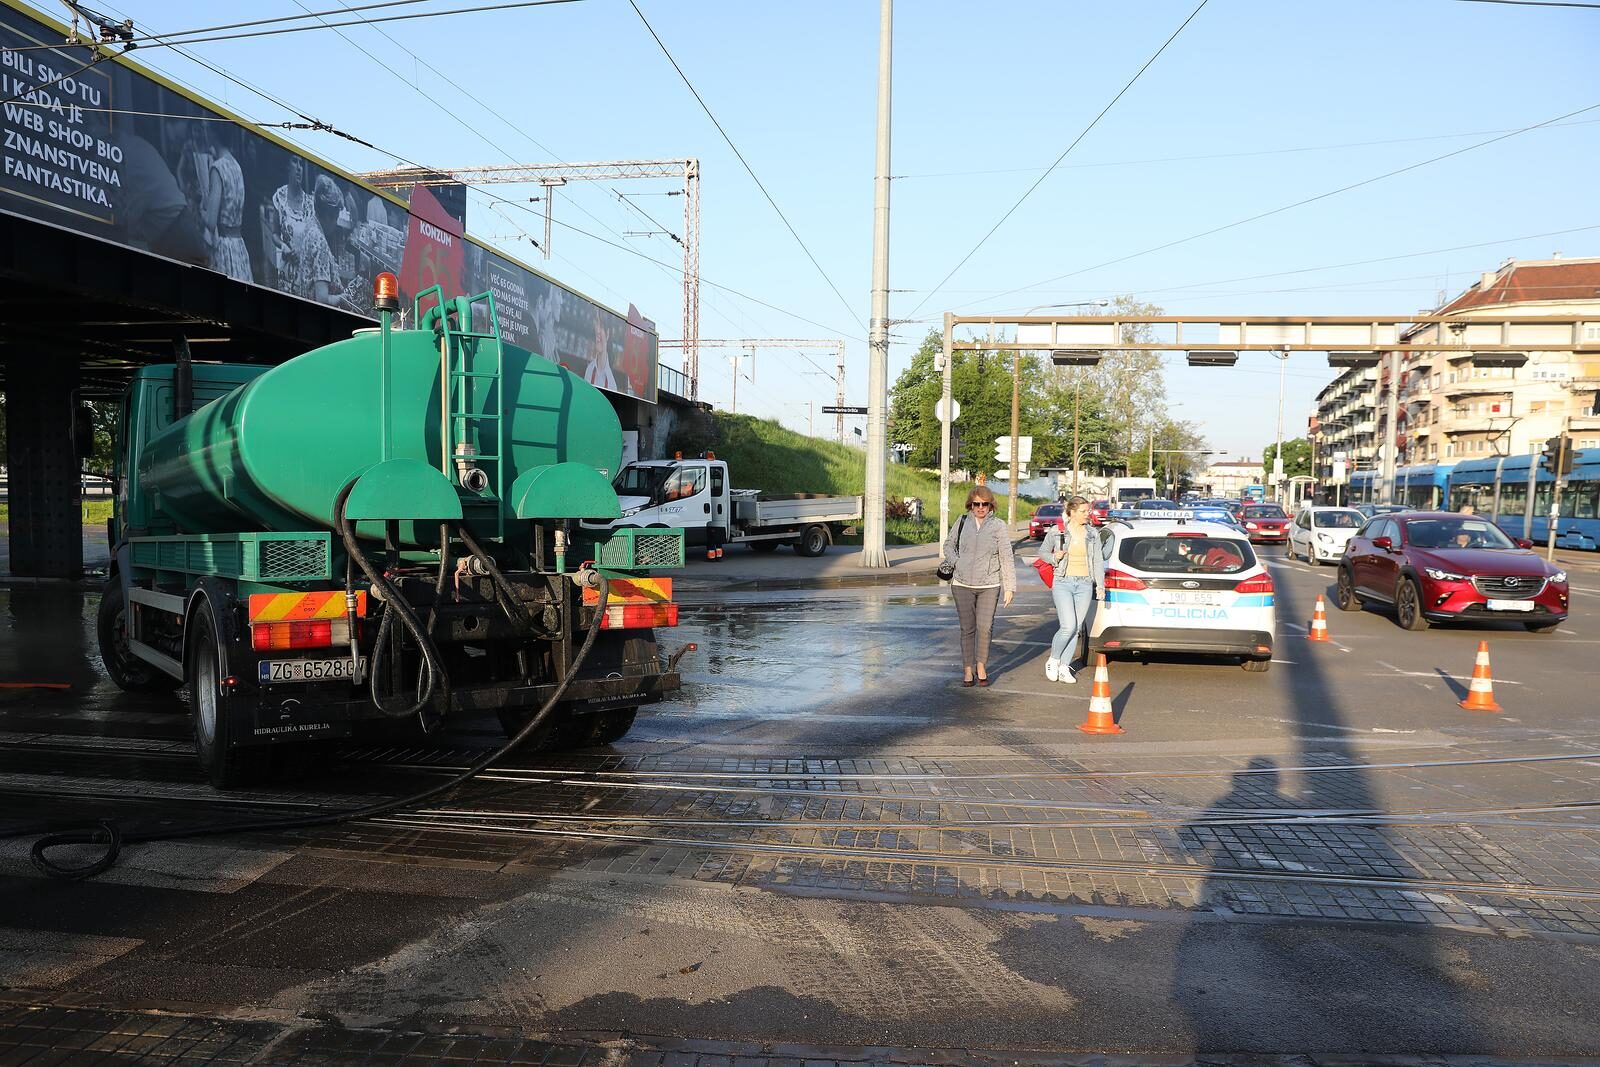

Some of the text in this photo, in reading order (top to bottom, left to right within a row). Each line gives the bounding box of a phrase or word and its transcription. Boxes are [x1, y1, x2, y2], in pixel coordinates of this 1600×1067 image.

[2, 47, 101, 106] BILI SMO TU
[3, 73, 84, 124] I KADA JE
[3, 102, 123, 163] WEB SHOP BIO
[4, 128, 121, 187] ZNANSTVENA
[4, 156, 113, 208] FANTASTIKA.
[420, 219, 452, 248] KONZUM
[506, 280, 525, 297] GODINA
[1142, 510, 1191, 518] POLICIJA
[1152, 607, 1229, 619] POLICIJA
[272, 662, 292, 680] ZG
[254, 725, 298, 736] HIDRAULIKA
